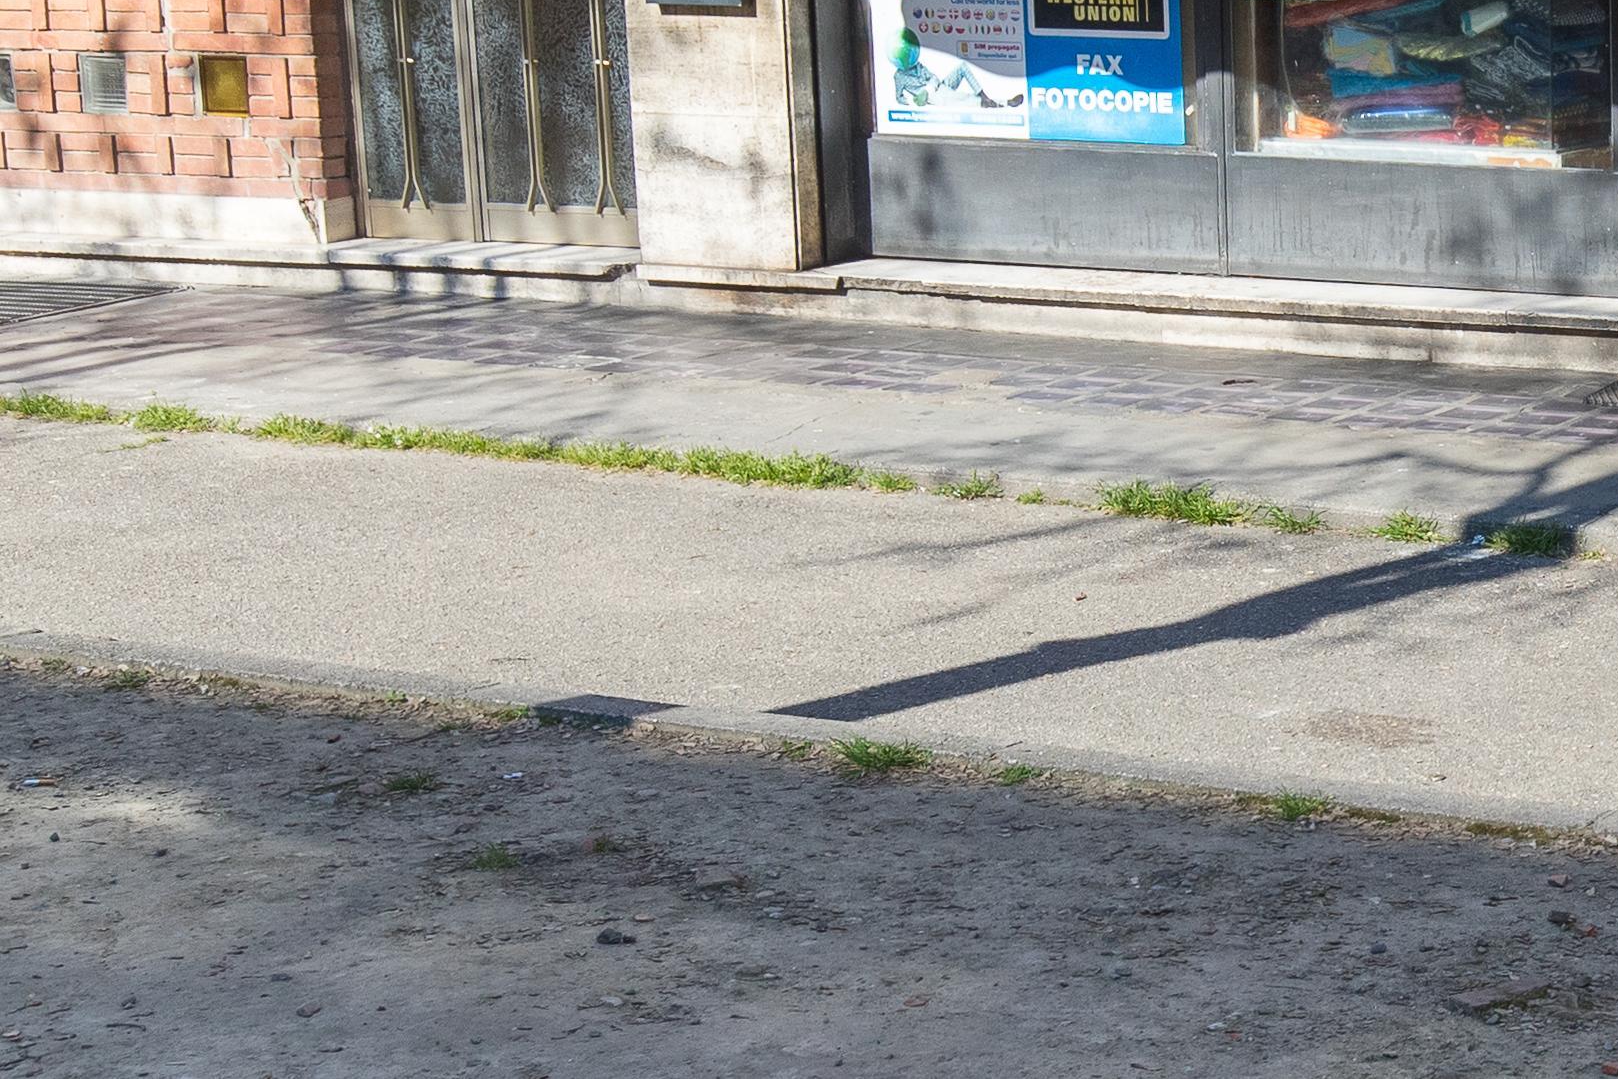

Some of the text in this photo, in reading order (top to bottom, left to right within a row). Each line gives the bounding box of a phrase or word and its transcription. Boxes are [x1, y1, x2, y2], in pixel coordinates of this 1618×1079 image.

[1074, 5, 1136, 22] UNION
[1076, 54, 1124, 75] FAX
[1030, 87, 1174, 114] FOTOCOPIE
